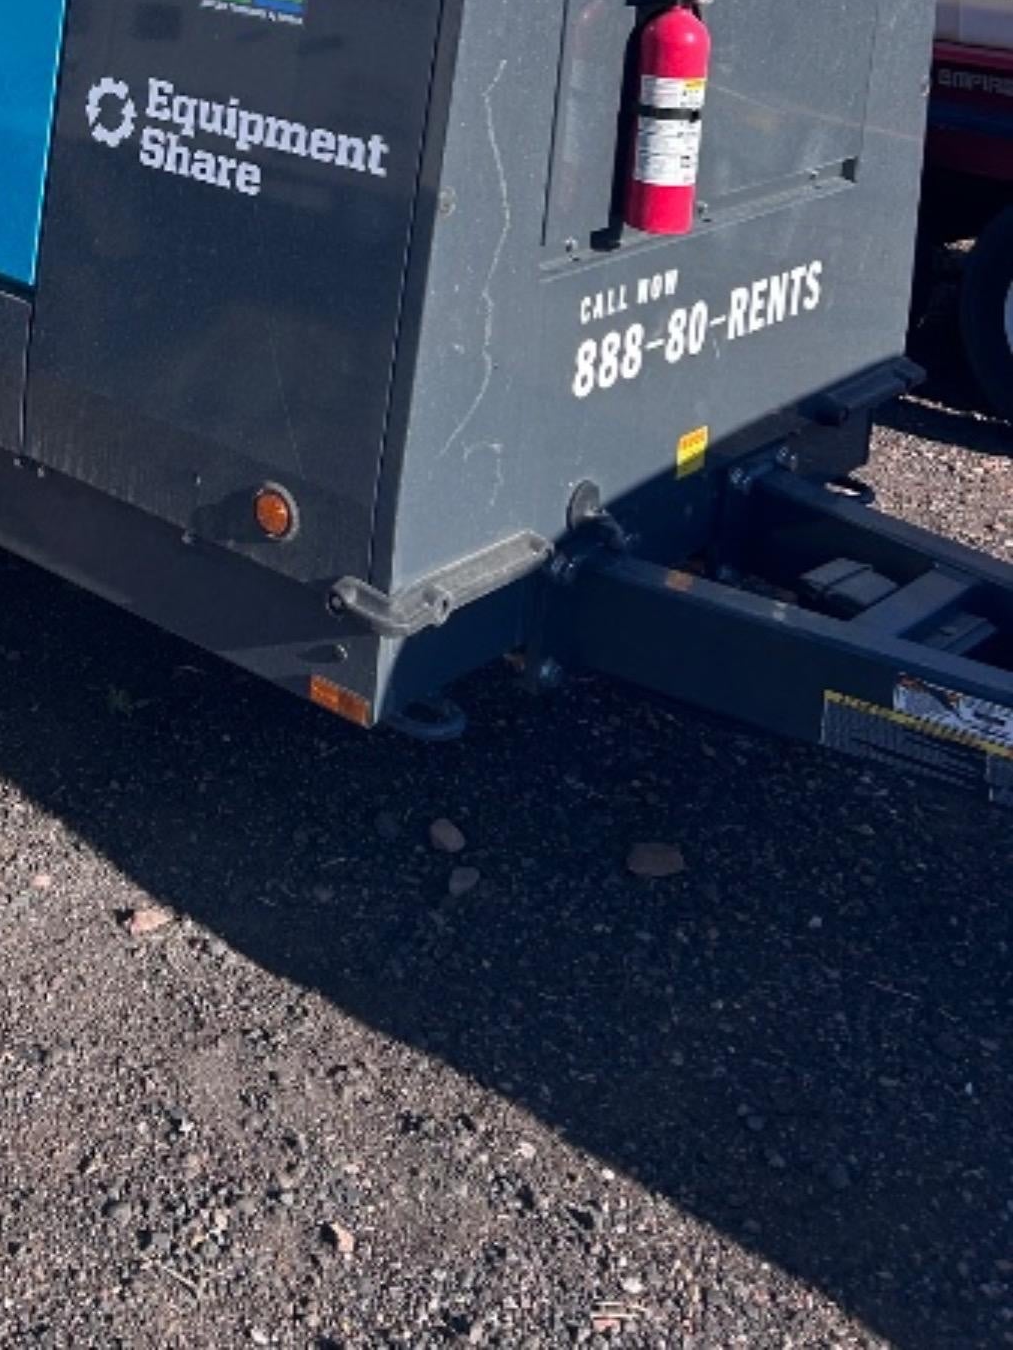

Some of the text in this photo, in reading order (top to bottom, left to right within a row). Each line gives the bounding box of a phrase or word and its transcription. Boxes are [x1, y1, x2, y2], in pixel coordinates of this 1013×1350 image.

[139, 127, 262, 196] Share
[145, 77, 390, 177] Equipment
[572, 260, 823, 398] 888-80-RENTS
[580, 268, 679, 325] CALL NOW
